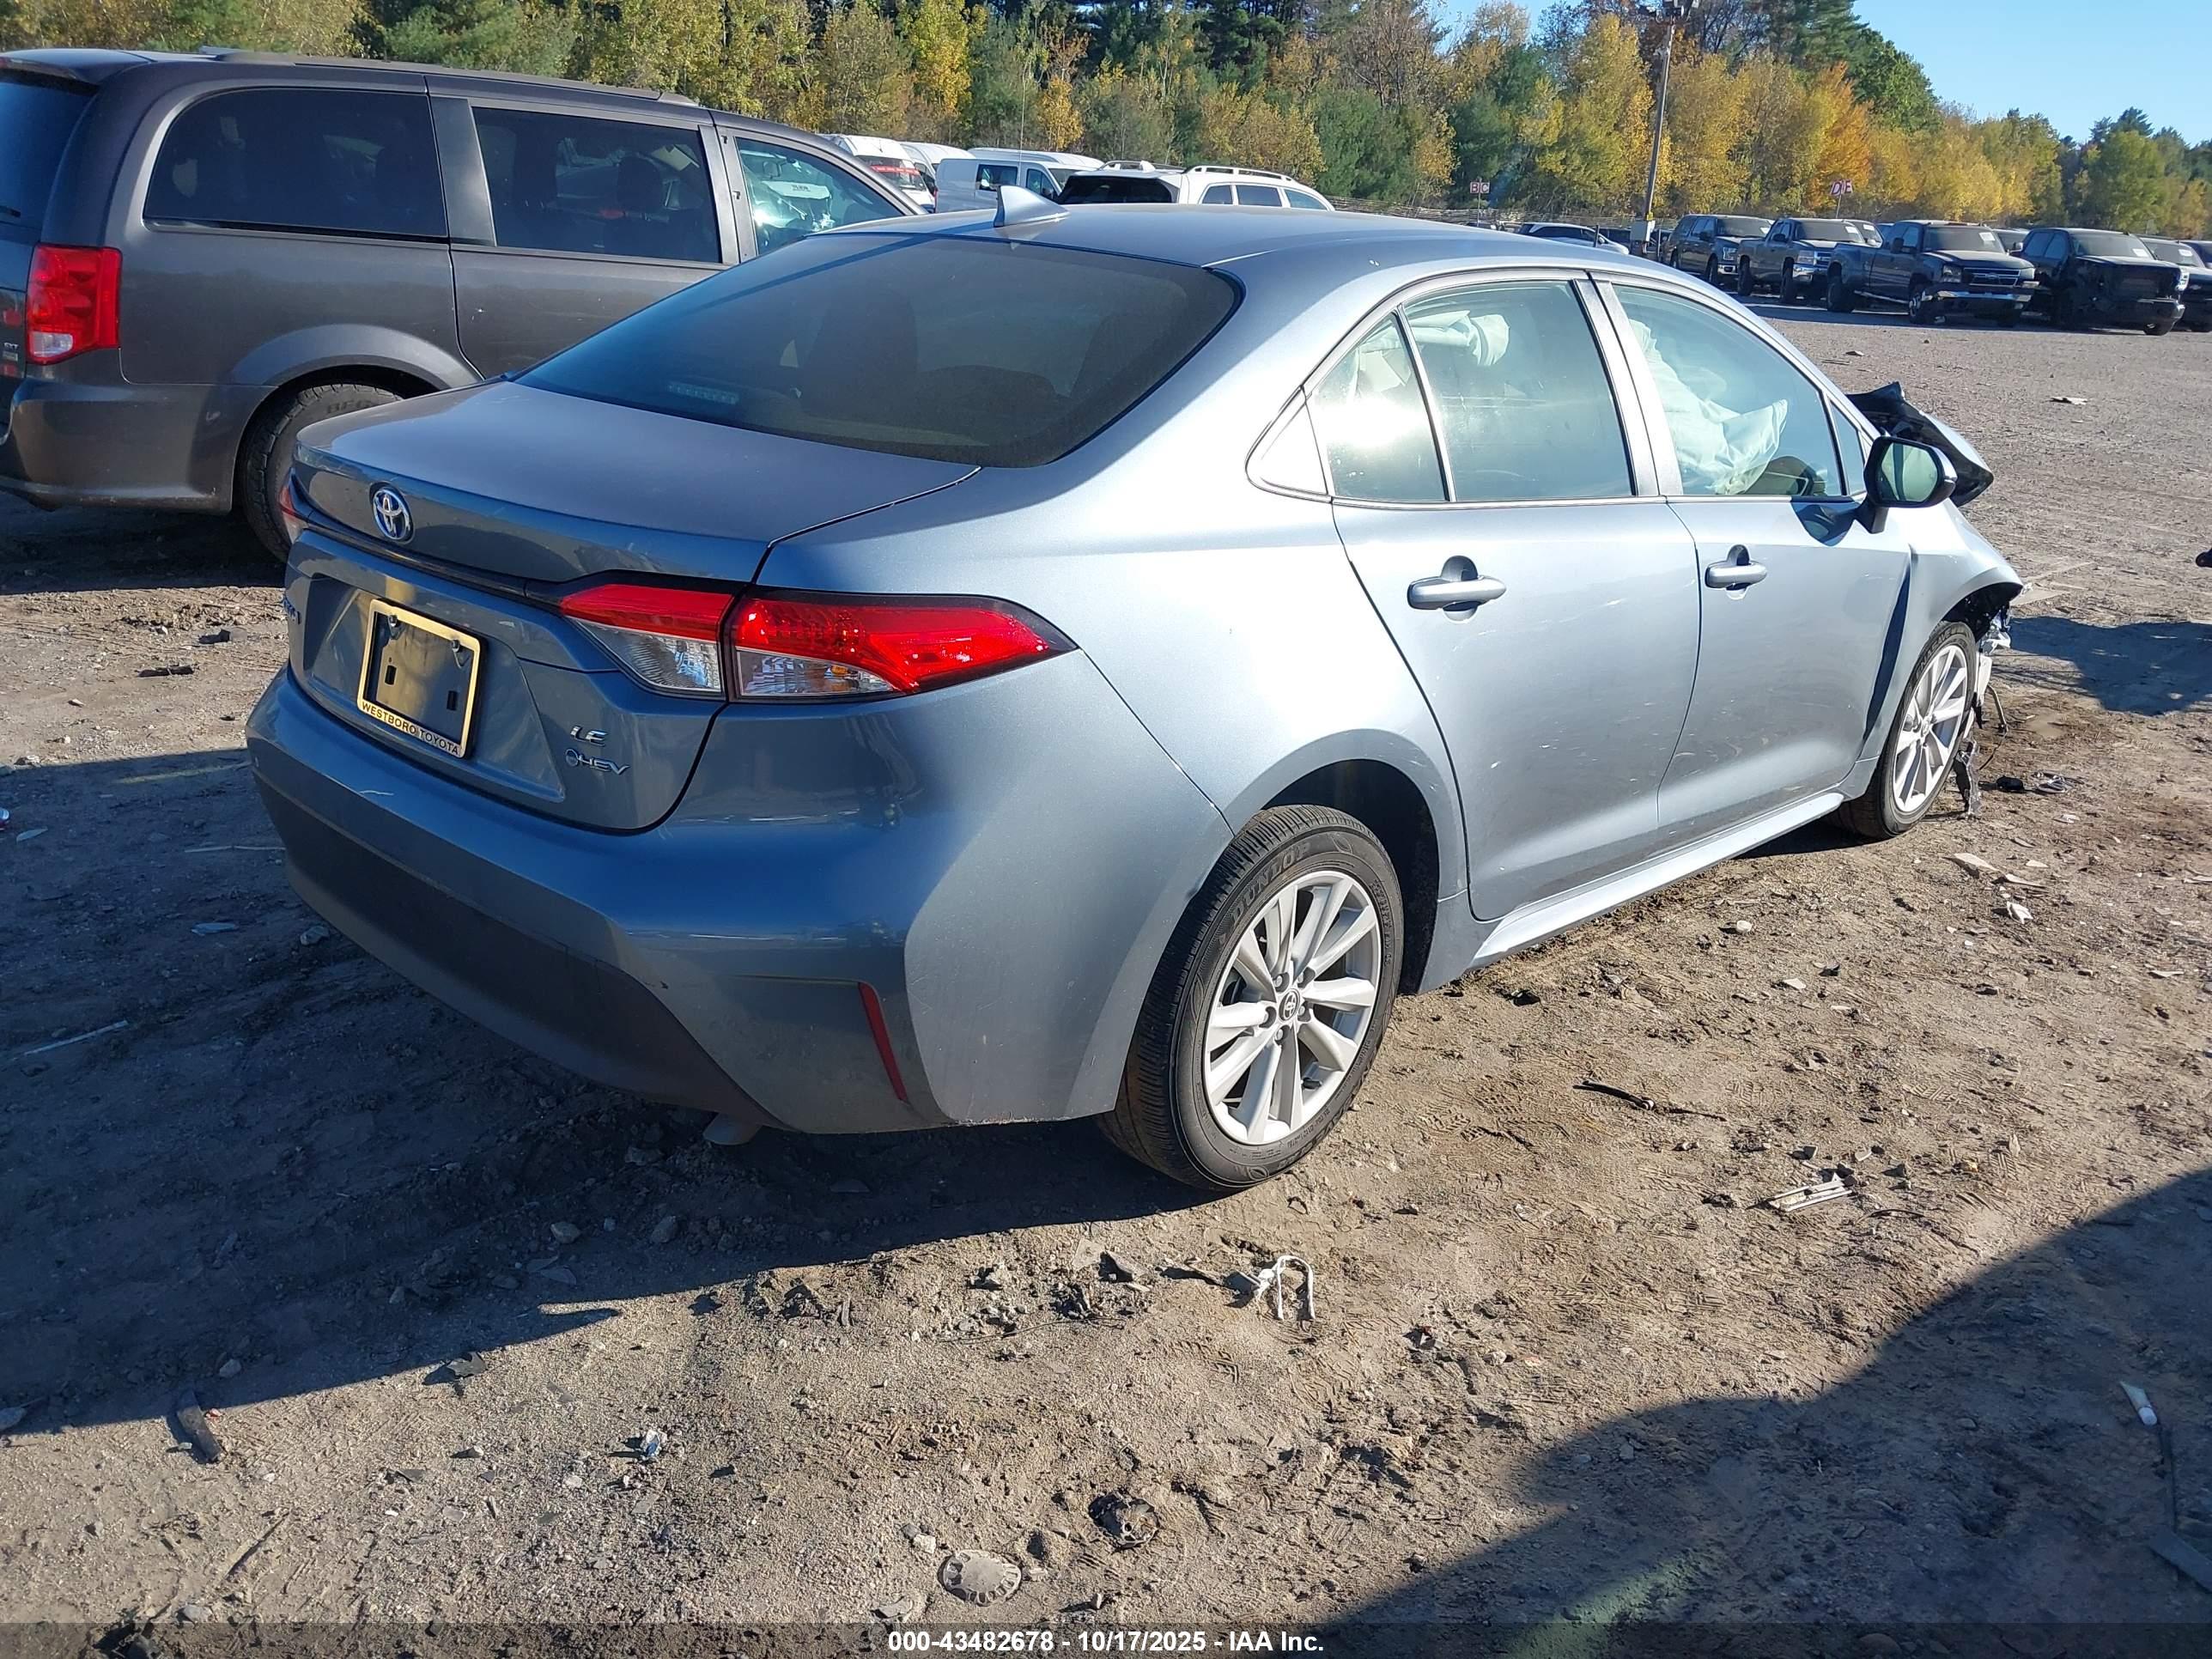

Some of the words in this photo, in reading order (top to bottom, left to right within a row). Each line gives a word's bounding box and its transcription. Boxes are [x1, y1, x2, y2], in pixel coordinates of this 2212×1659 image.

[361, 701, 417, 735] WESTBORO
[418, 728, 459, 757] TOYOTA
[569, 725, 608, 747] LE
[1231, 842, 1311, 926] DUNLOP
